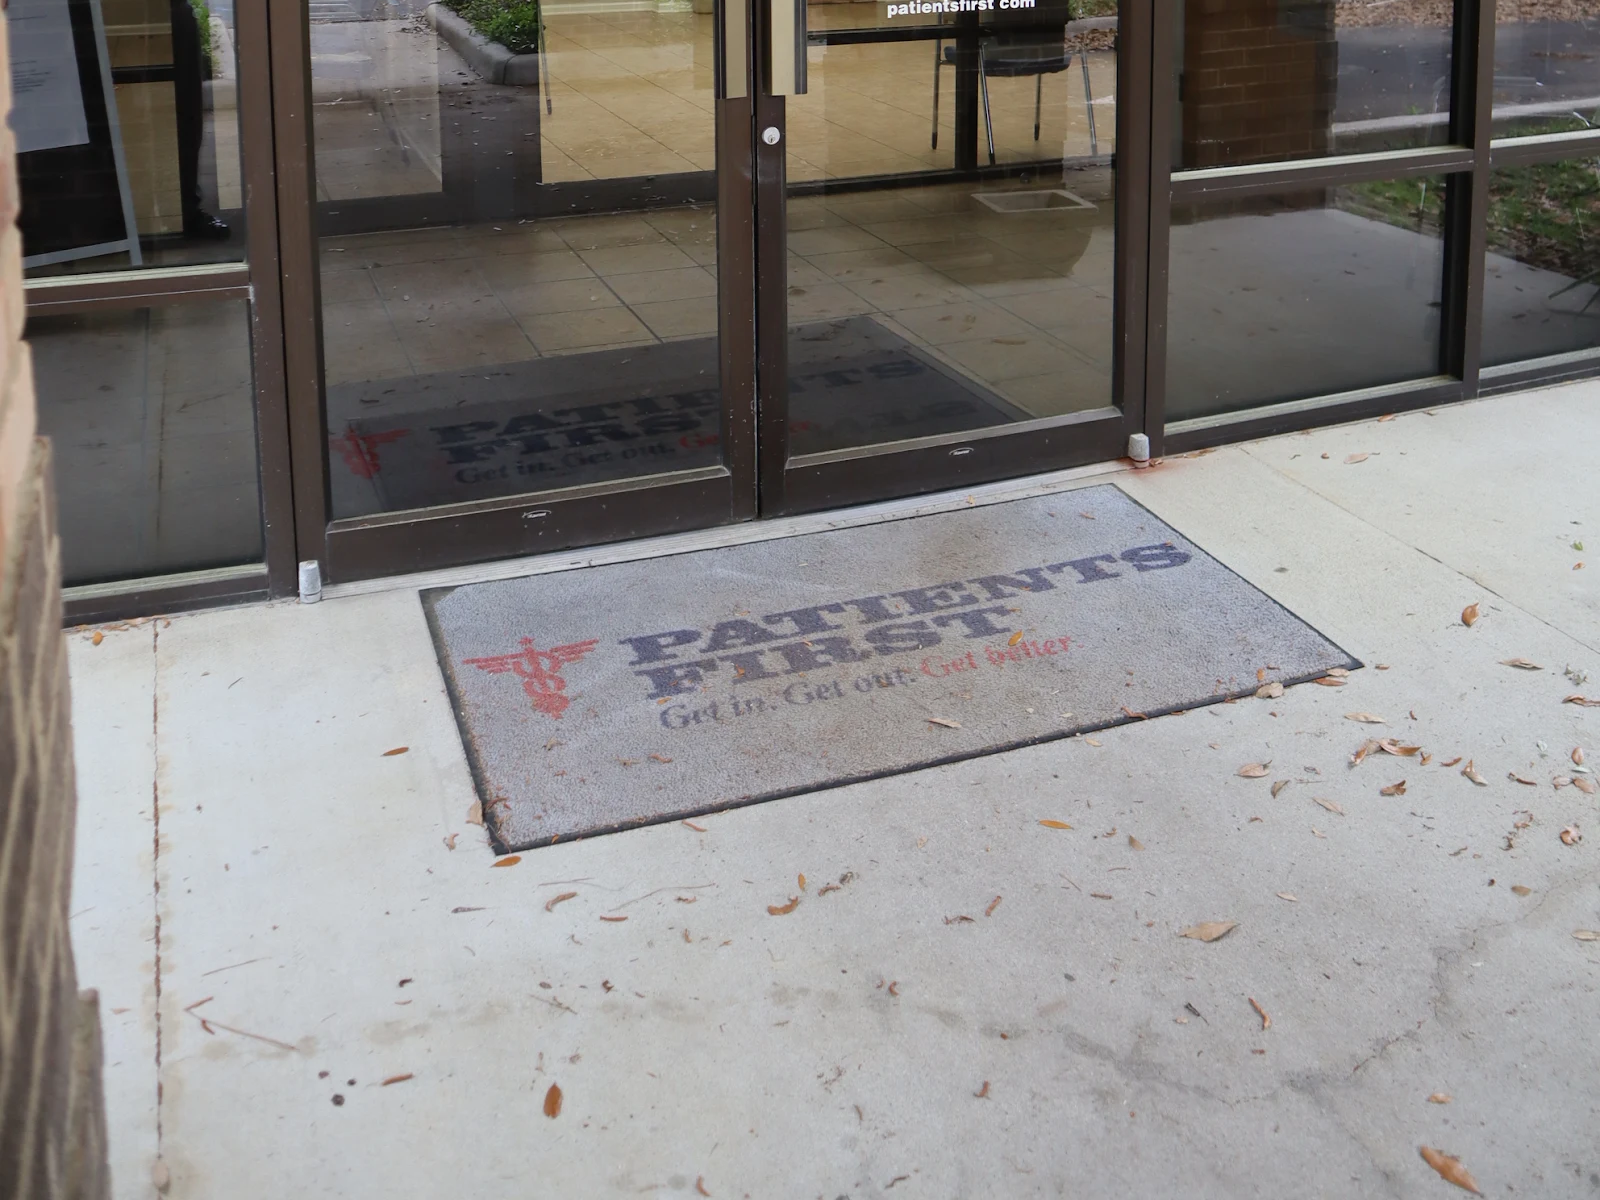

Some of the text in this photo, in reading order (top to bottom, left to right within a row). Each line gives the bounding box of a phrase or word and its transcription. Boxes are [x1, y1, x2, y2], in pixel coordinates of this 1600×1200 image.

[440, 405, 719, 465] FIRS
[619, 541, 1194, 666] PATIENTS
[634, 605, 1013, 700] FIRST
[659, 698, 718, 730] Get
[783, 677, 842, 707] Get
[844, 667, 916, 695] out.
[919, 650, 976, 680] Get
[983, 633, 1085, 668] better.
